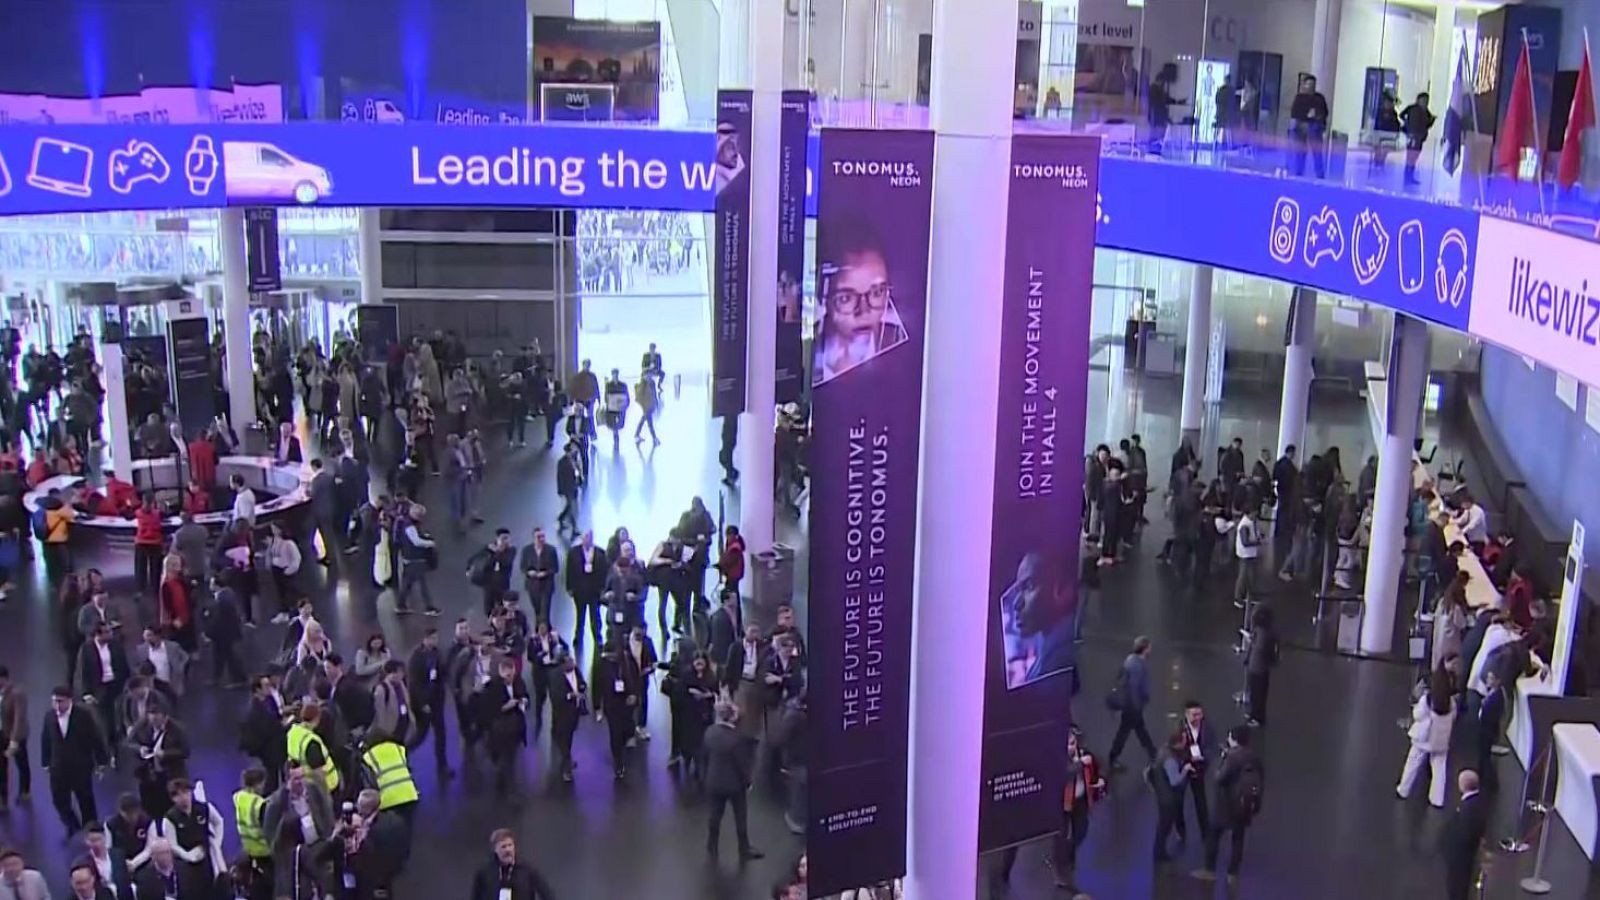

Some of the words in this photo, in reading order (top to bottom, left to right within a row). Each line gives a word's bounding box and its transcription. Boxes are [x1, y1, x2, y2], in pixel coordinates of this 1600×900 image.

[1102, 22, 1133, 38] level
[411, 146, 586, 196] Leading
[597, 150, 668, 189] the
[832, 161, 919, 176] TONOMUS.
[890, 175, 921, 187] NEOM
[1013, 164, 1087, 179] TONOMUS.
[1062, 178, 1088, 189] NEOM
[1508, 256, 1600, 346] likewiz
[1024, 266, 1044, 395] MOVEMENT
[1044, 386, 1058, 401] 4
[1022, 401, 1037, 444] THE
[1041, 406, 1057, 466] HALL
[847, 417, 866, 563] COGNITIVE.
[870, 425, 888, 559] TONOMUS.
[1020, 451, 1036, 497] JOIN
[1040, 473, 1052, 494] IN
[846, 569, 862, 589] IS
[869, 564, 885, 585] IS
[845, 595, 861, 681] FUTURE
[867, 591, 884, 678] FUTURE
[843, 687, 860, 731] THE
[865, 682, 882, 726] THE
[828, 815, 874, 832] SOLUTIONS
